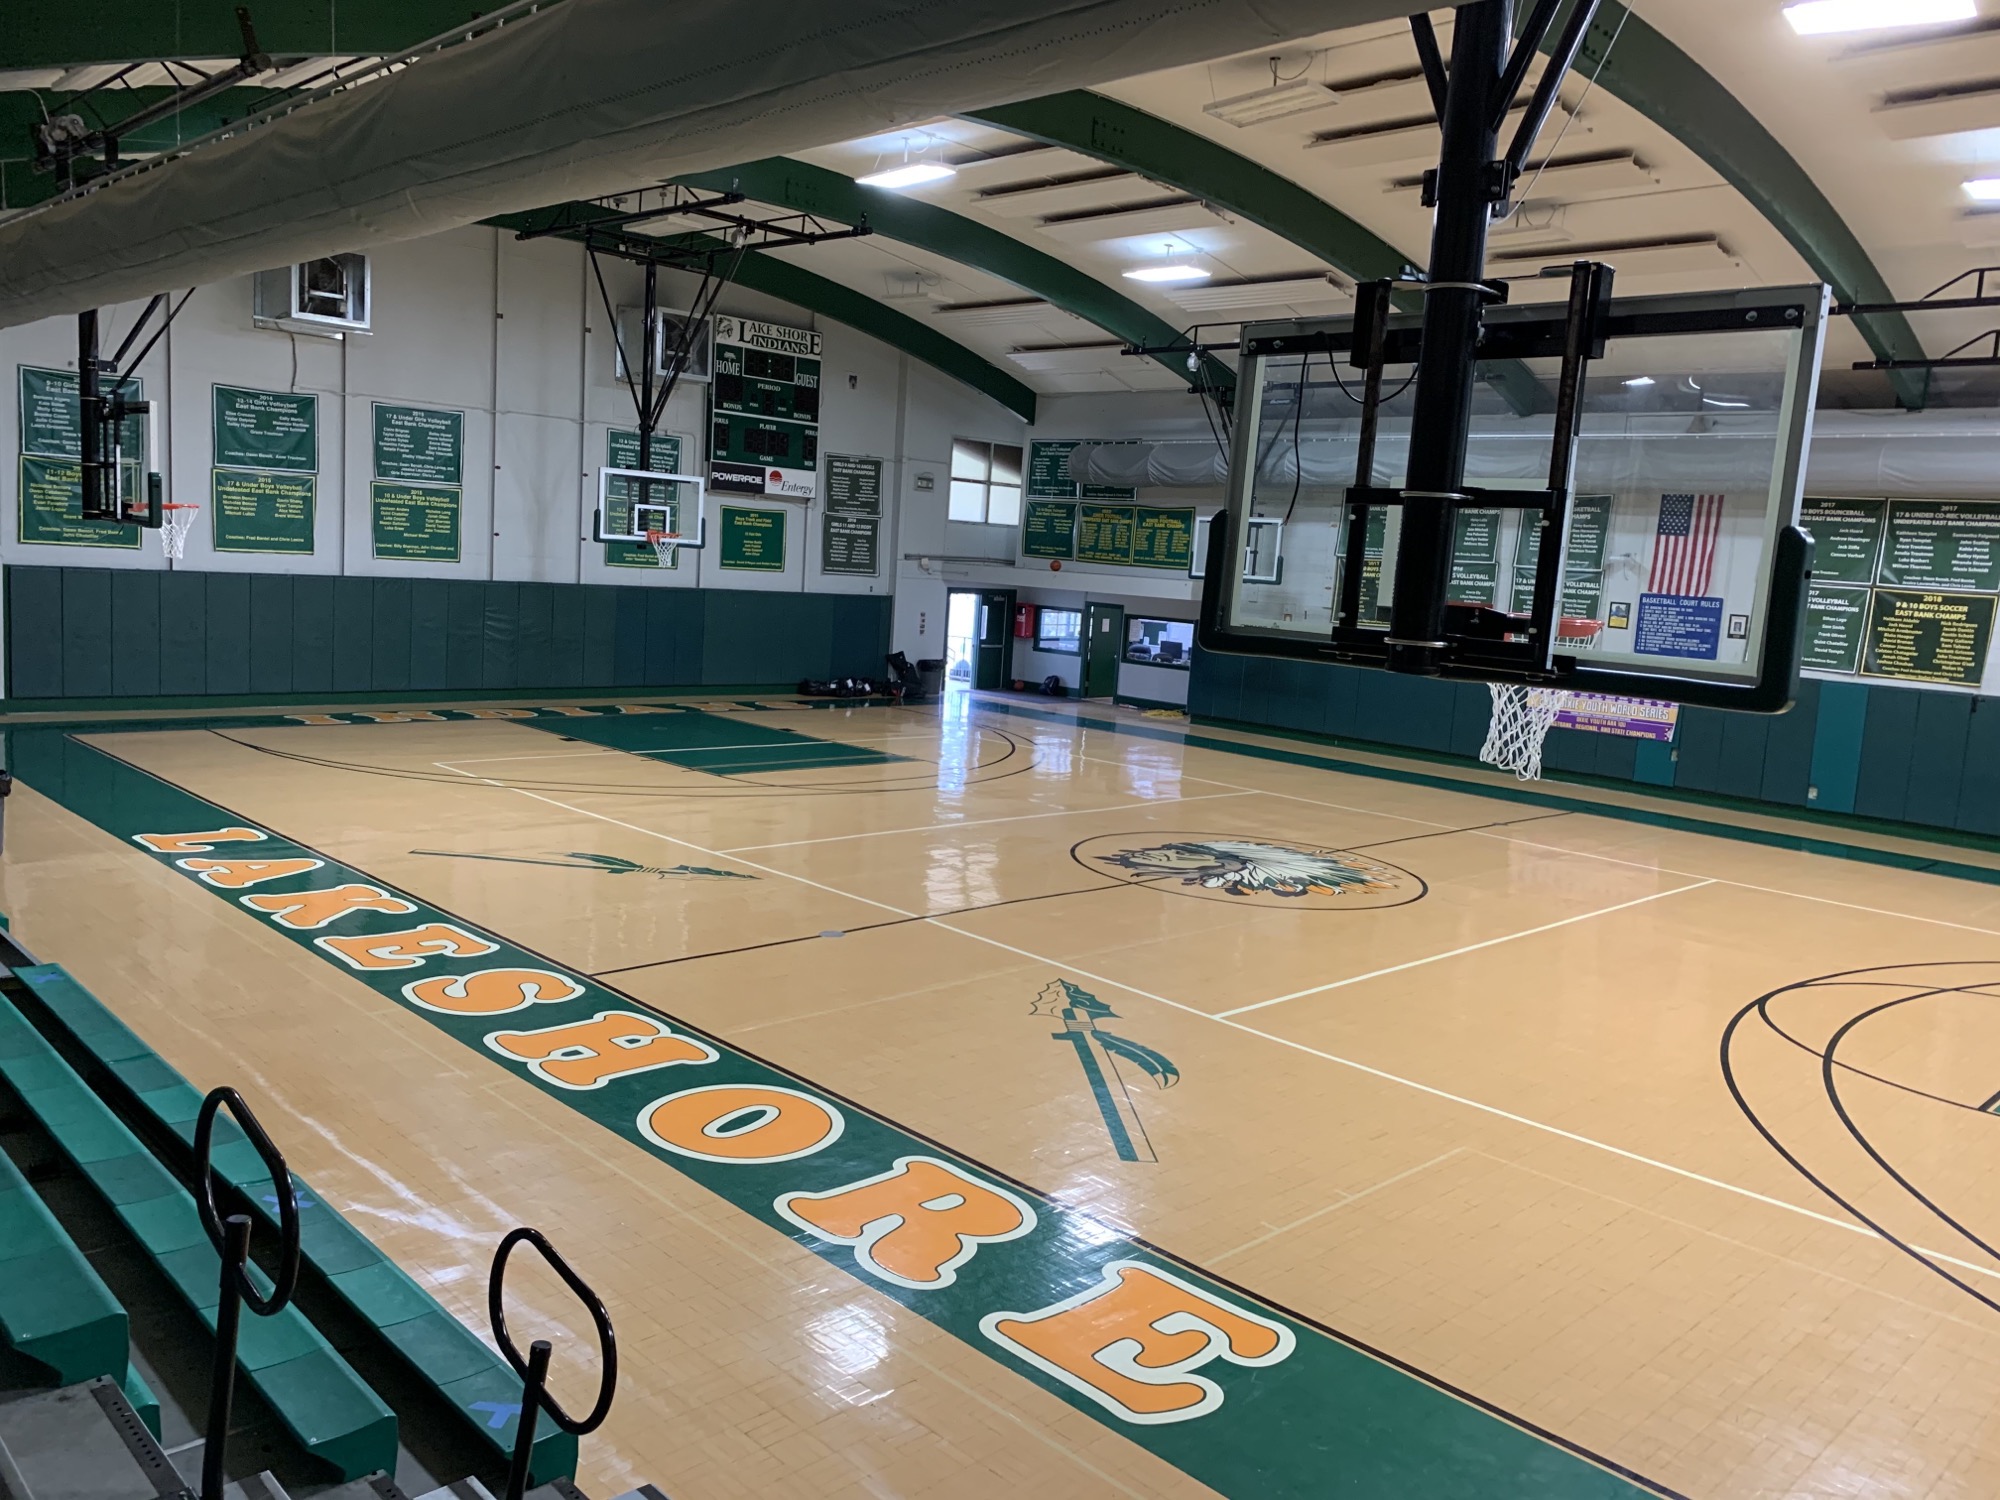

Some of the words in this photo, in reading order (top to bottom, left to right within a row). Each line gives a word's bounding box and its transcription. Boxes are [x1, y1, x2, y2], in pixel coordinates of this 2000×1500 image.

[738, 320, 772, 344] LAKE
[776, 326, 822, 355] SHORE
[752, 336, 808, 354] INDIANS
[716, 360, 740, 376] HOME
[758, 383, 780, 392] PERIOD
[796, 373, 818, 388] GUEST
[712, 472, 764, 484] POWERADE
[781, 480, 814, 496] Entergy
[1642, 597, 1676, 606] BASKETBALL
[1936, 612, 1966, 620] CHAMPS
[1582, 701, 1608, 712] YOUTH
[1610, 704, 1637, 716] WORLD
[1640, 707, 1669, 720] SERIES
[1626, 729, 1656, 738] CHAMPIONS
[131, 827, 1298, 1425] LAKESHORE
